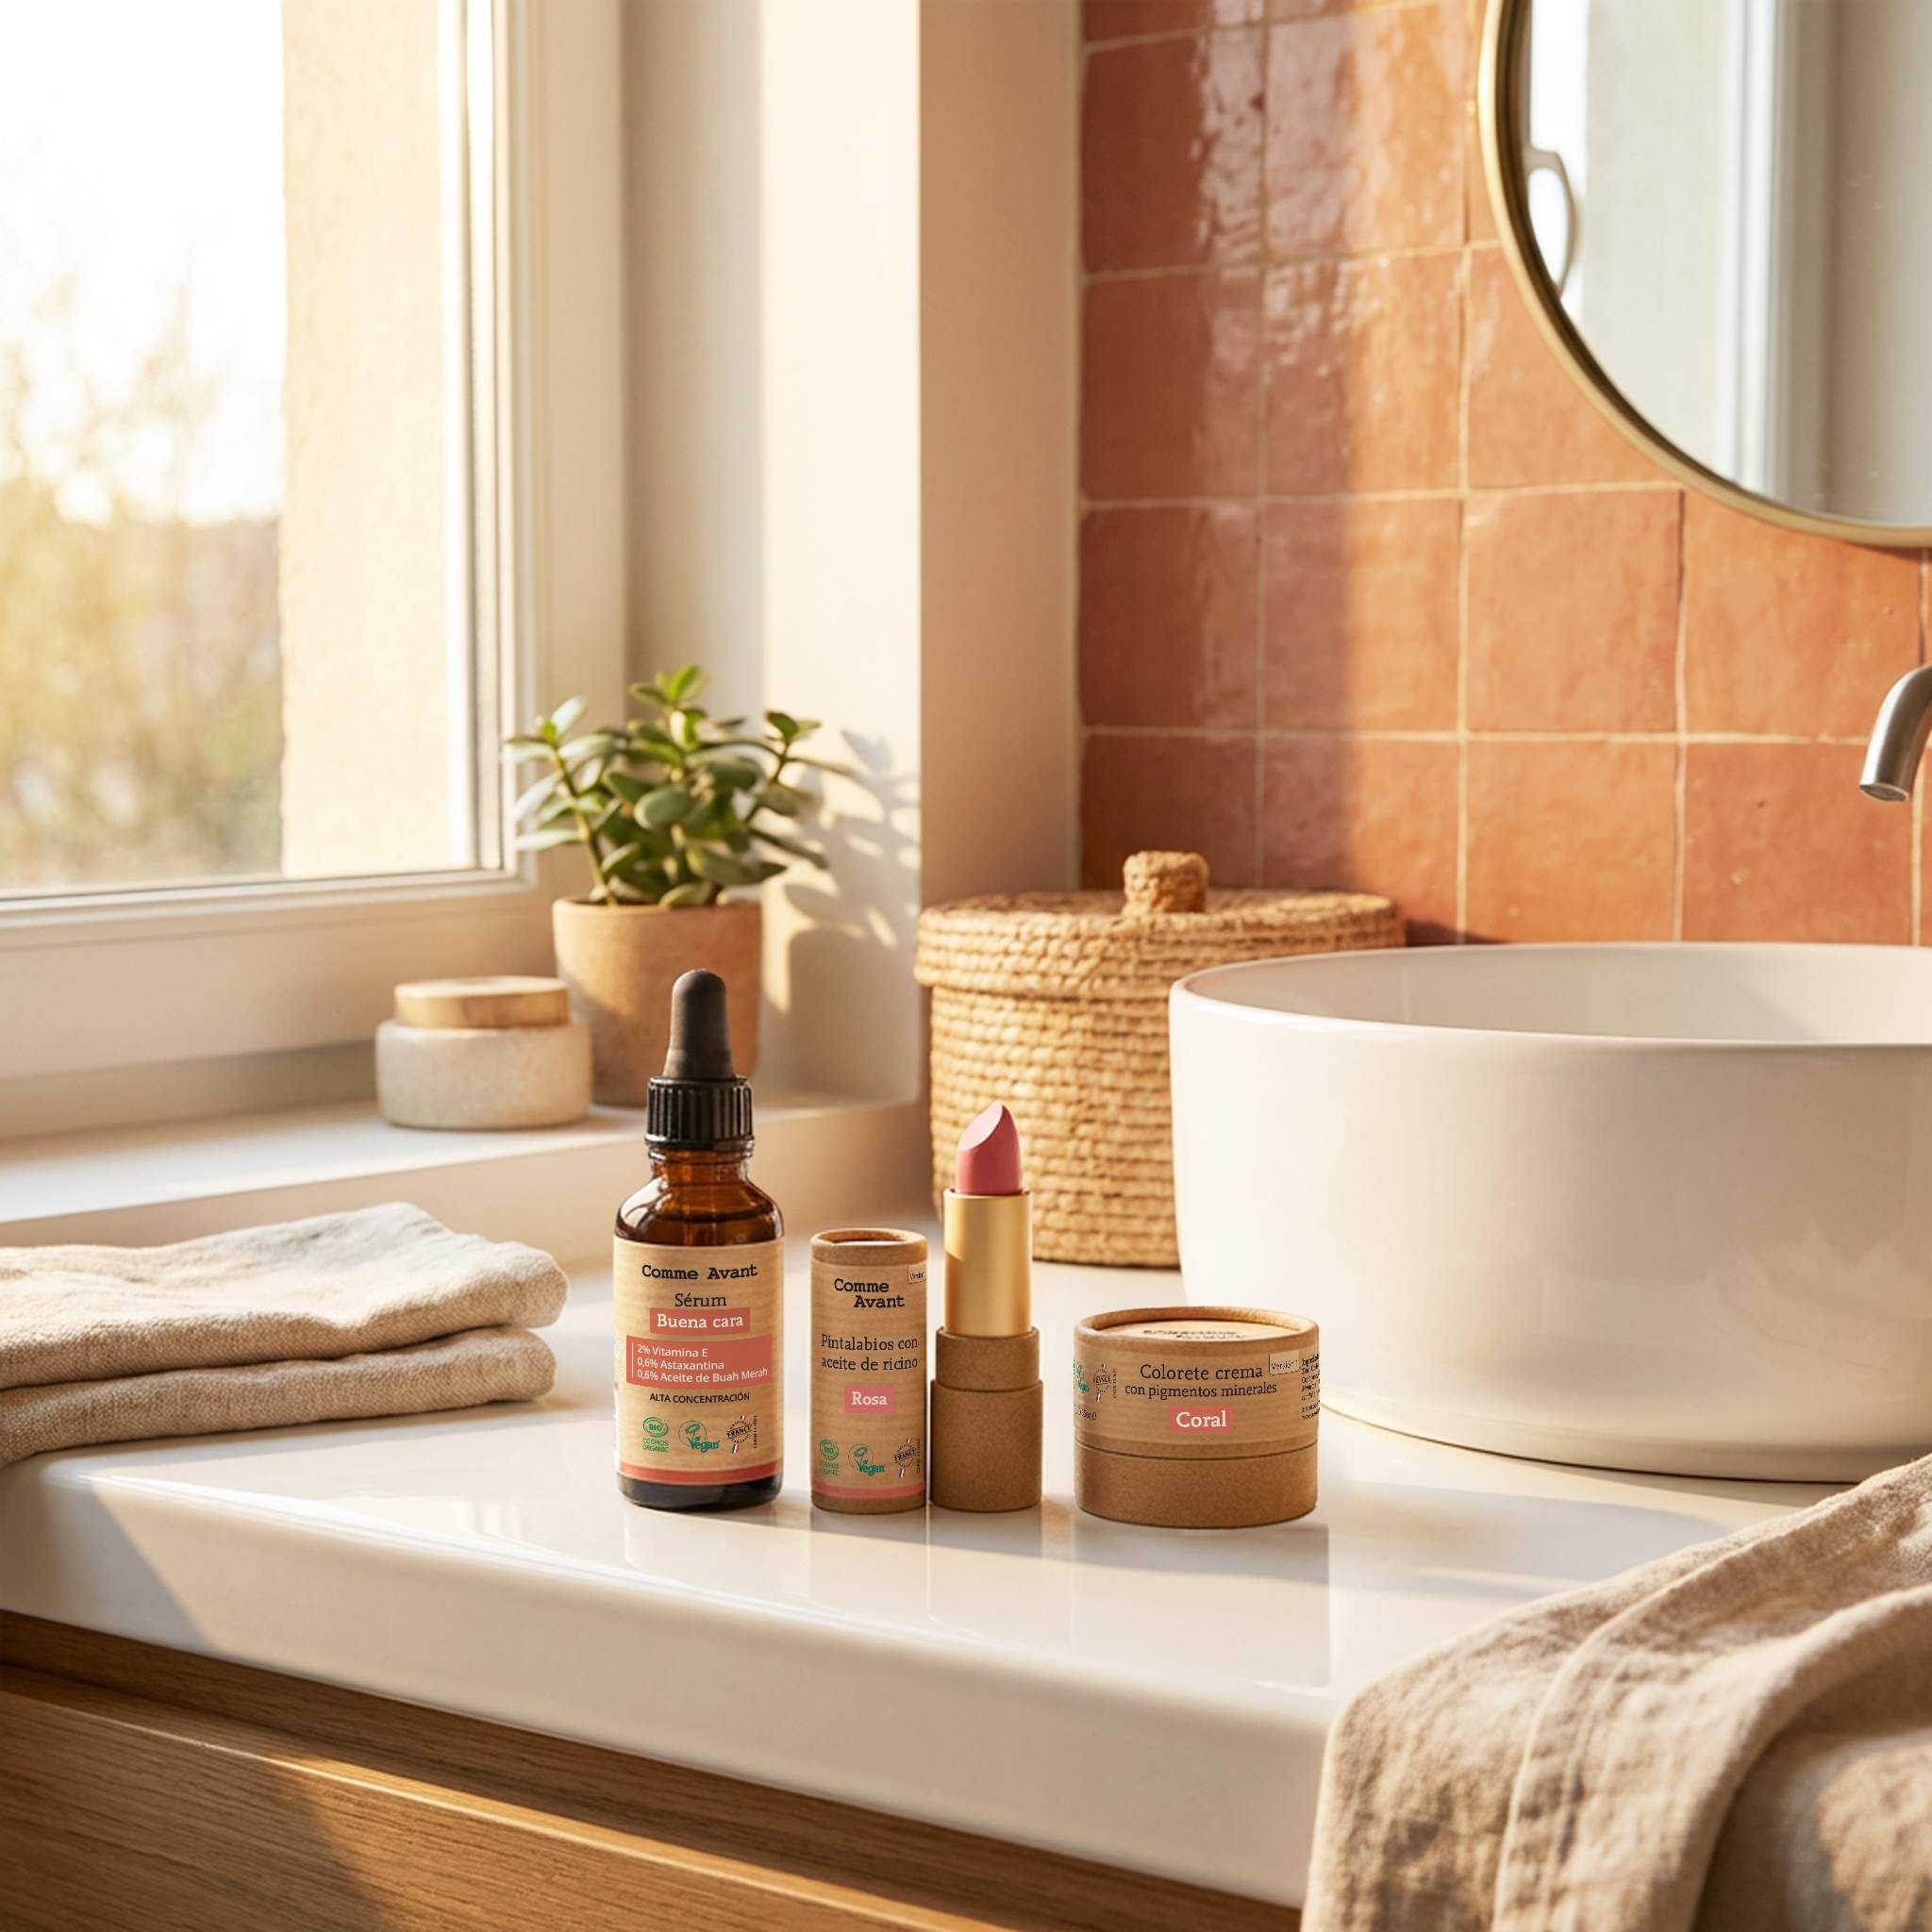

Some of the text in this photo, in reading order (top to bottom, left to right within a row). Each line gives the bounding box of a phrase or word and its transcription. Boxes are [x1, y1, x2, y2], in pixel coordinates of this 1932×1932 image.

[641, 1264, 758, 1280] Comme Avant
[834, 1278, 890, 1293] Comme
[675, 1292, 727, 1307] Sérum
[854, 1294, 906, 1308] Avant
[657, 1313, 743, 1328] Buena cara
[637, 1343, 708, 1357] 2% Vitamina E
[821, 1334, 918, 1351] Pintalabios con
[637, 1357, 724, 1371] 0,6% Astaxantina
[822, 1356, 918, 1371] aceite de ricino
[637, 1367, 768, 1383] 0,6% Aceite de Buah Merah
[1140, 1363, 1263, 1380] Colorete crema
[649, 1391, 750, 1404] ALTA CONCENTRACIÓN
[851, 1391, 888, 1406] Rosa
[1124, 1381, 1277, 1401] con pigmentos minerales
[1175, 1409, 1227, 1428] Coral
[648, 1423, 662, 1432] BIO
[726, 1424, 752, 1440] FRANCE
[689, 1437, 720, 1453] Vegan
